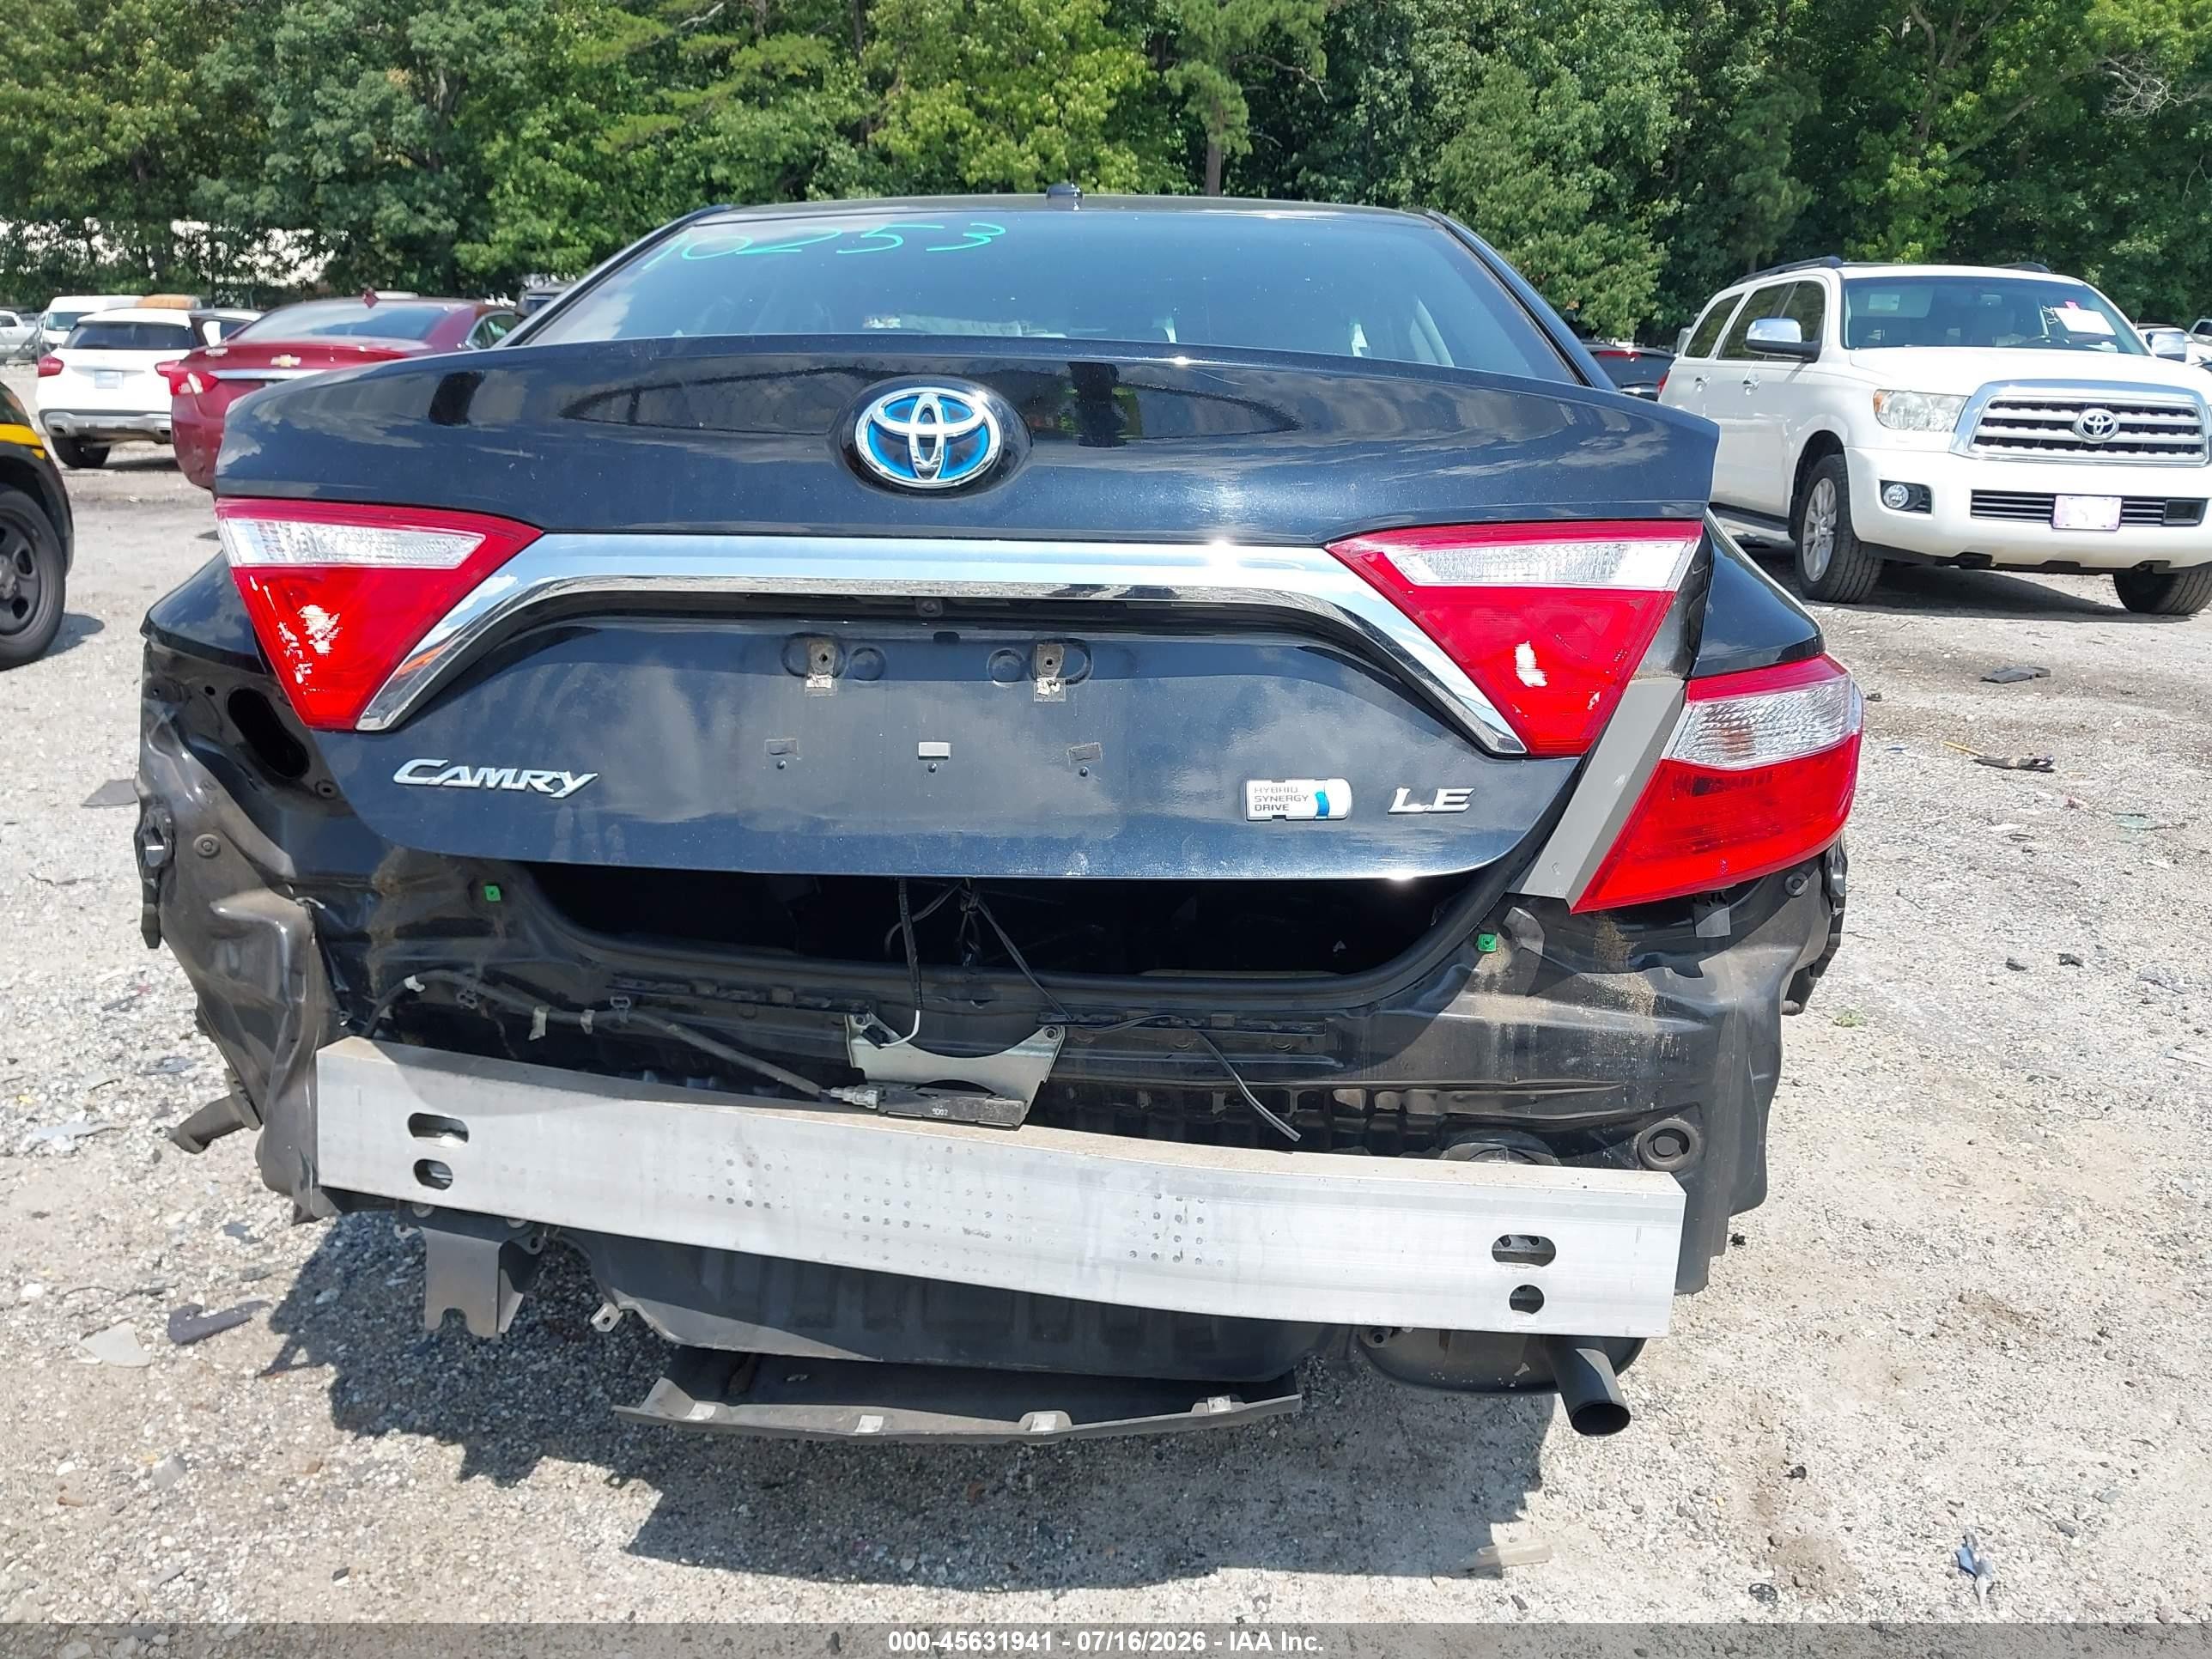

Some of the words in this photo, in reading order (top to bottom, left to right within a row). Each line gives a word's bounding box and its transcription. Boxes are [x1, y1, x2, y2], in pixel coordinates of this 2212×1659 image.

[642, 223, 1007, 269] 10253
[392, 758, 599, 799] CAMRY
[1388, 787, 1475, 814] LE
